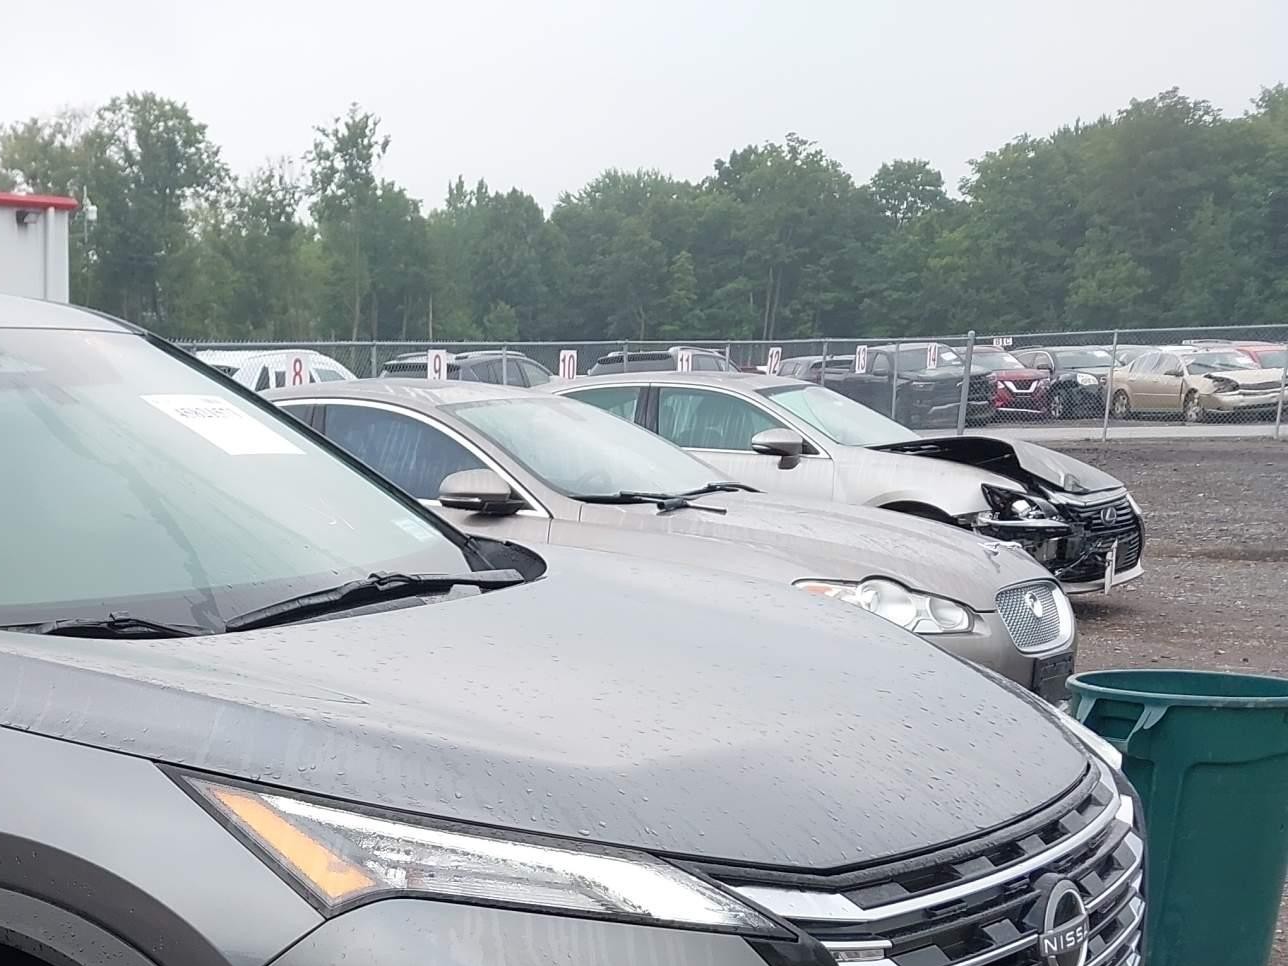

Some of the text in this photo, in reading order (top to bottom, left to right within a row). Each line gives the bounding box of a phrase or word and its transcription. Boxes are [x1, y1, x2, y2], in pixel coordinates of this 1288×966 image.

[292, 357, 303, 386] 8
[433, 353, 442, 380] 9
[561, 353, 575, 380] 10
[769, 349, 780, 375] 12
